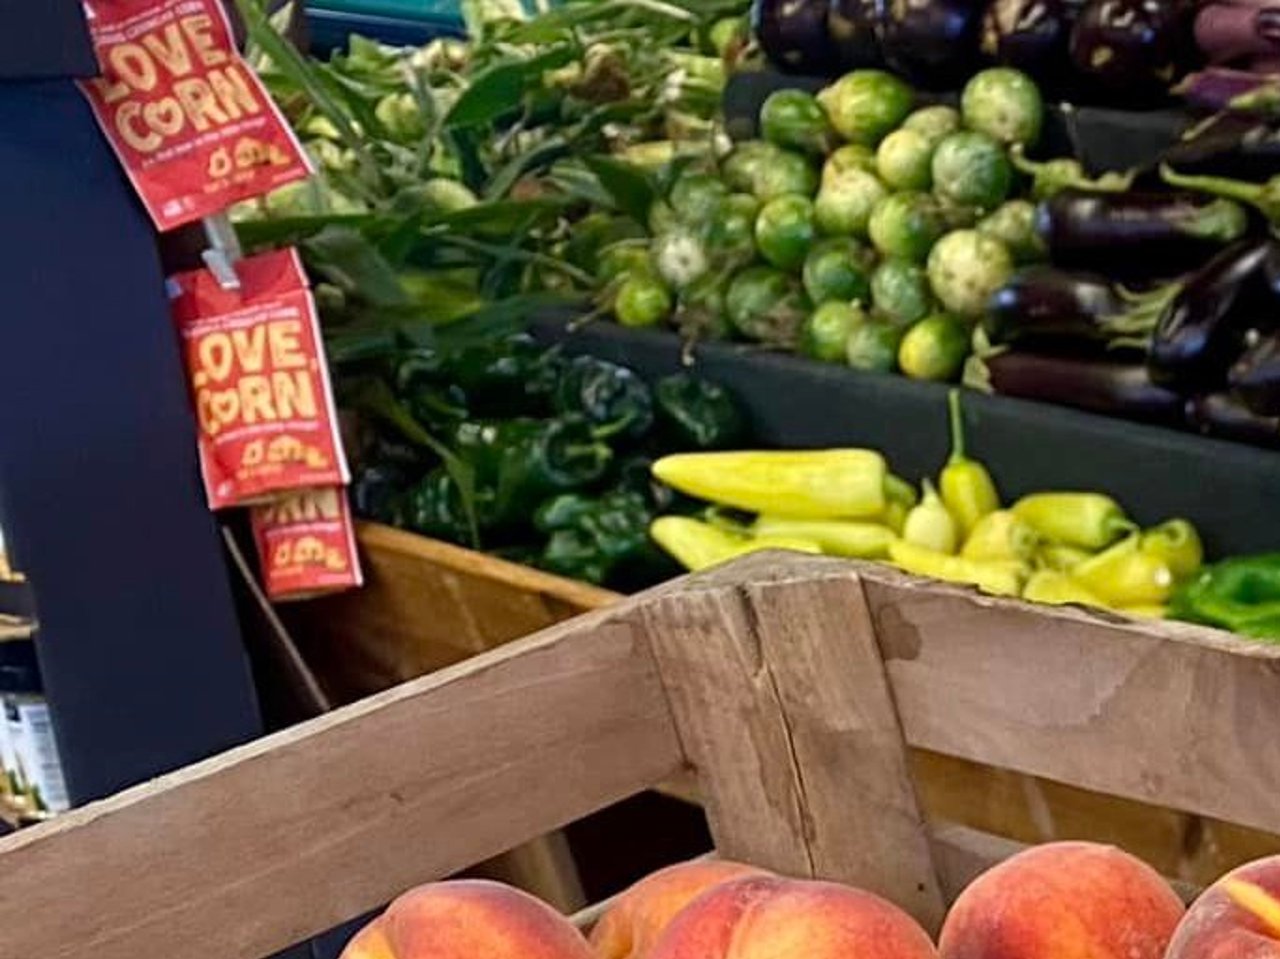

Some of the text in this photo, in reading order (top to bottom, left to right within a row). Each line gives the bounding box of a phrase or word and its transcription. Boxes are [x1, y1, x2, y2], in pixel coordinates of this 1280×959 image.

[98, 14, 227, 103] LOVE
[115, 66, 260, 152] CORN
[194, 319, 306, 387] OVE
